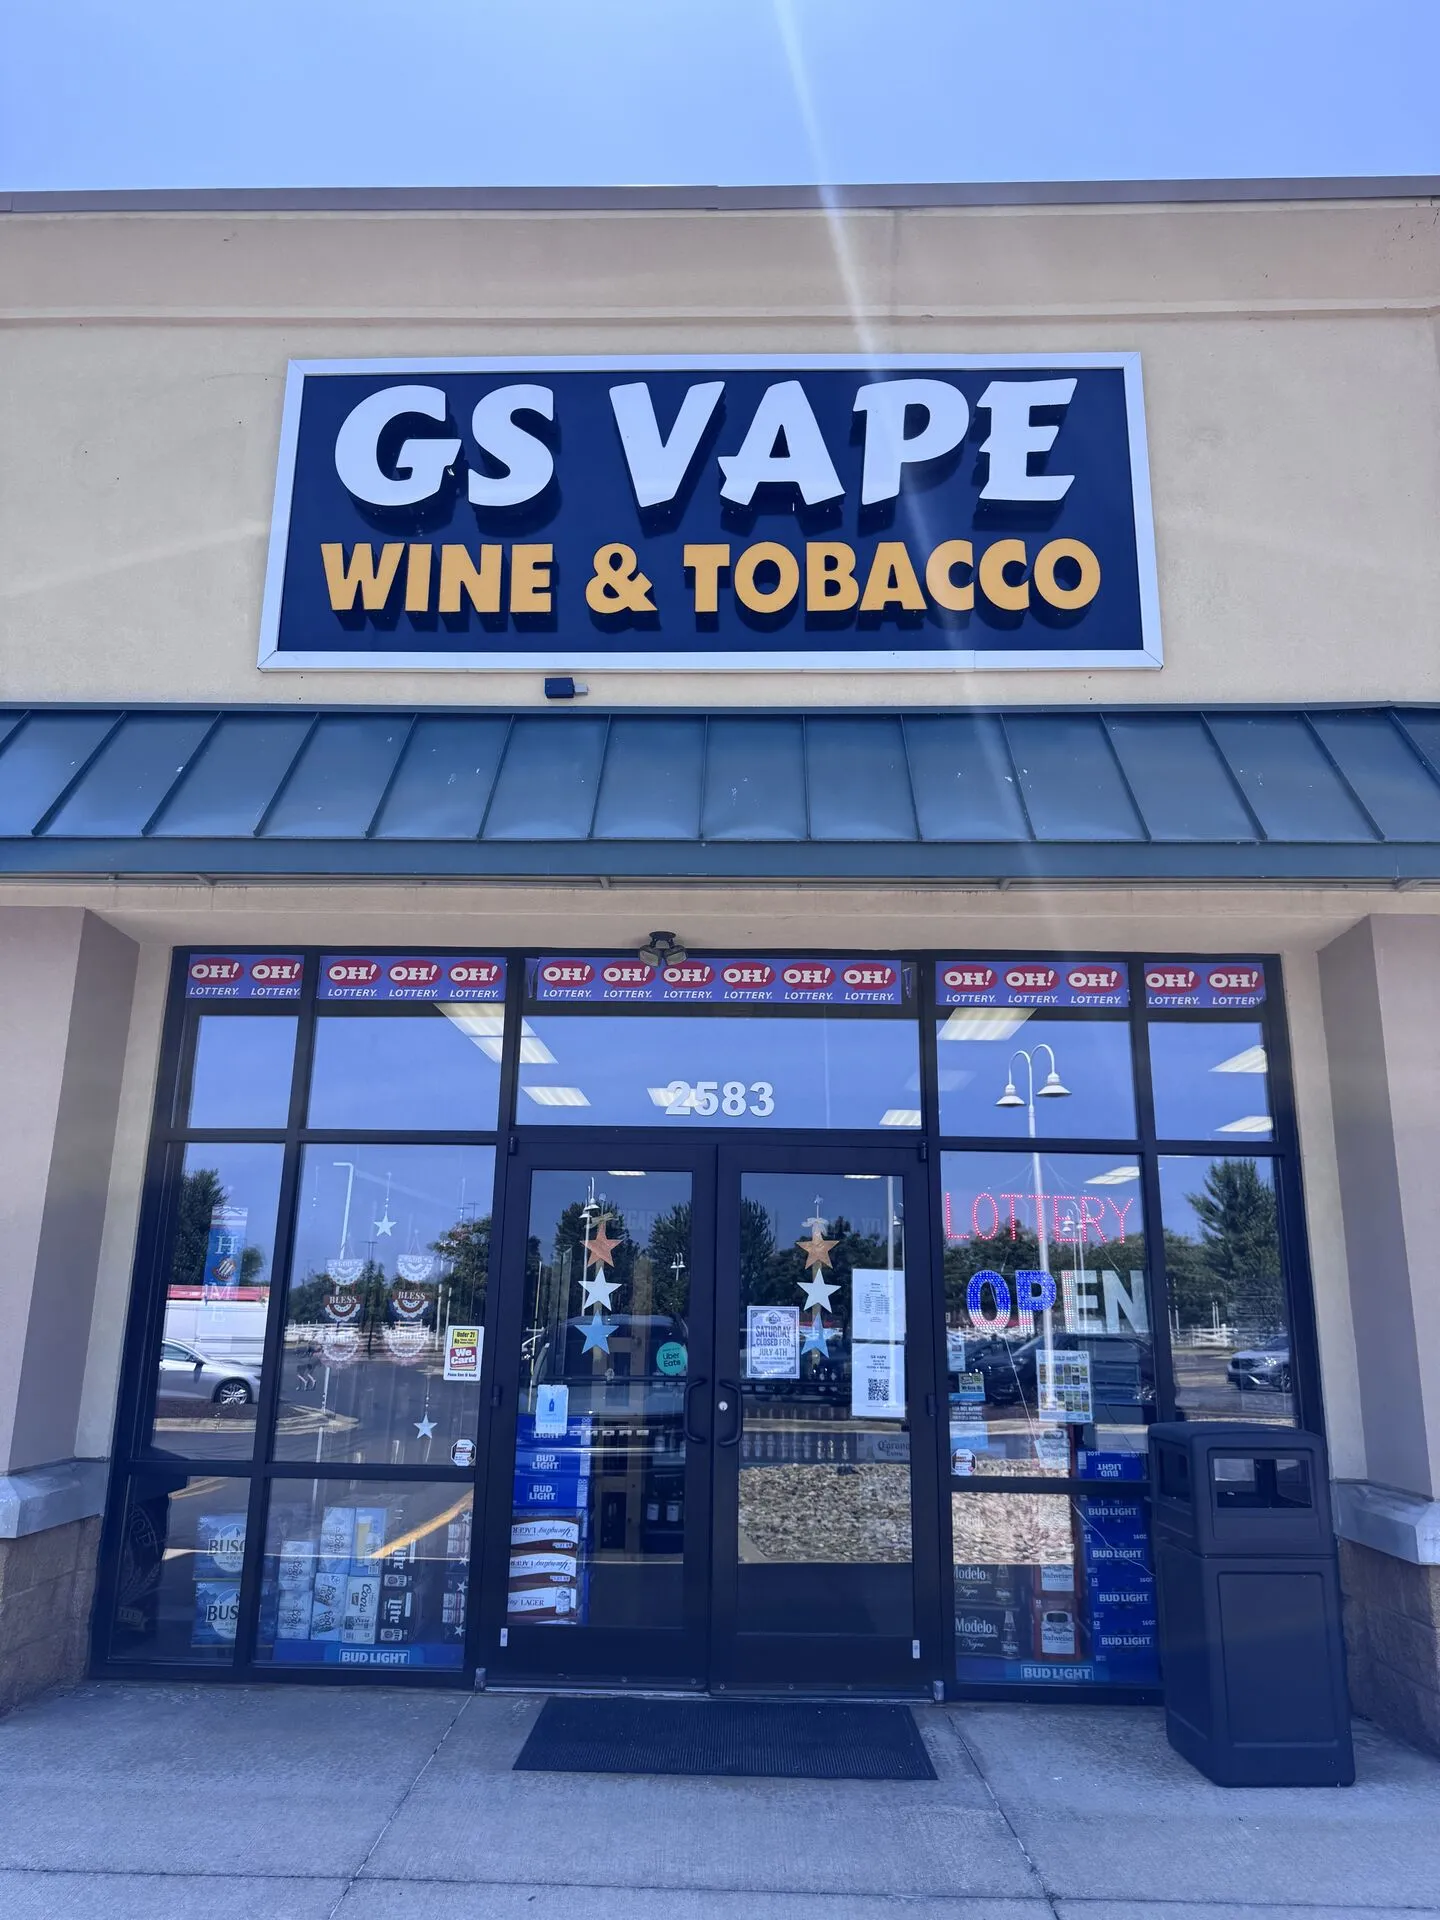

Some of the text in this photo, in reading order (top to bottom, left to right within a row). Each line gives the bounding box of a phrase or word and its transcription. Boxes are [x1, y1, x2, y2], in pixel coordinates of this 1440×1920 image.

[334, 378, 1078, 508] GS VAPE
[321, 538, 1100, 613] WINE & TOBACCO
[191, 962, 239, 979] OH!
[252, 963, 300, 979] OH!
[329, 964, 377, 980] OH!
[389, 964, 438, 981] OH!
[450, 965, 499, 981] OH!
[544, 965, 591, 981] OH!
[604, 965, 651, 982] OH!
[664, 966, 711, 982] OH!
[724, 966, 771, 982] OH!
[784, 967, 831, 983] OH!
[844, 968, 892, 984] OH!
[944, 970, 992, 986] OH!
[1006, 970, 1054, 986] OH!
[1068, 971, 1118, 987] OH!
[1146, 971, 1194, 988] OH!
[1209, 972, 1258, 989] OH!
[666, 1080, 774, 1116] 2583
[945, 1192, 1133, 1243] LOTTERY
[329, 1296, 357, 1304] BLESS
[398, 1292, 426, 1300] BLESS
[967, 1270, 1148, 1334] OPEN
[756, 1326, 791, 1338] SATURDAY
[756, 1338, 790, 1346] CLOSED FOR
[451, 1354, 475, 1364] Card
[455, 1348, 472, 1357] We
[663, 1352, 680, 1360] Uber
[760, 1348, 787, 1356] JULY 4TH
[532, 1462, 559, 1470] LIGHT
[529, 1492, 555, 1500] LIGHT
[1088, 1508, 1137, 1516] BUD LIGHT
[1092, 1550, 1142, 1558] BUD LIGHT
[360, 1584, 372, 1613] Coors
[1099, 1594, 1149, 1602] BUD LIGHT
[207, 1606, 239, 1620] BUS
[388, 1599, 402, 1623] Lite
[955, 1618, 992, 1633] Modelo
[1102, 1637, 1151, 1645] BUD LIGHT
[342, 1652, 407, 1664] BUD LIGHT
[1024, 1668, 1090, 1680] BUD LIGHT
